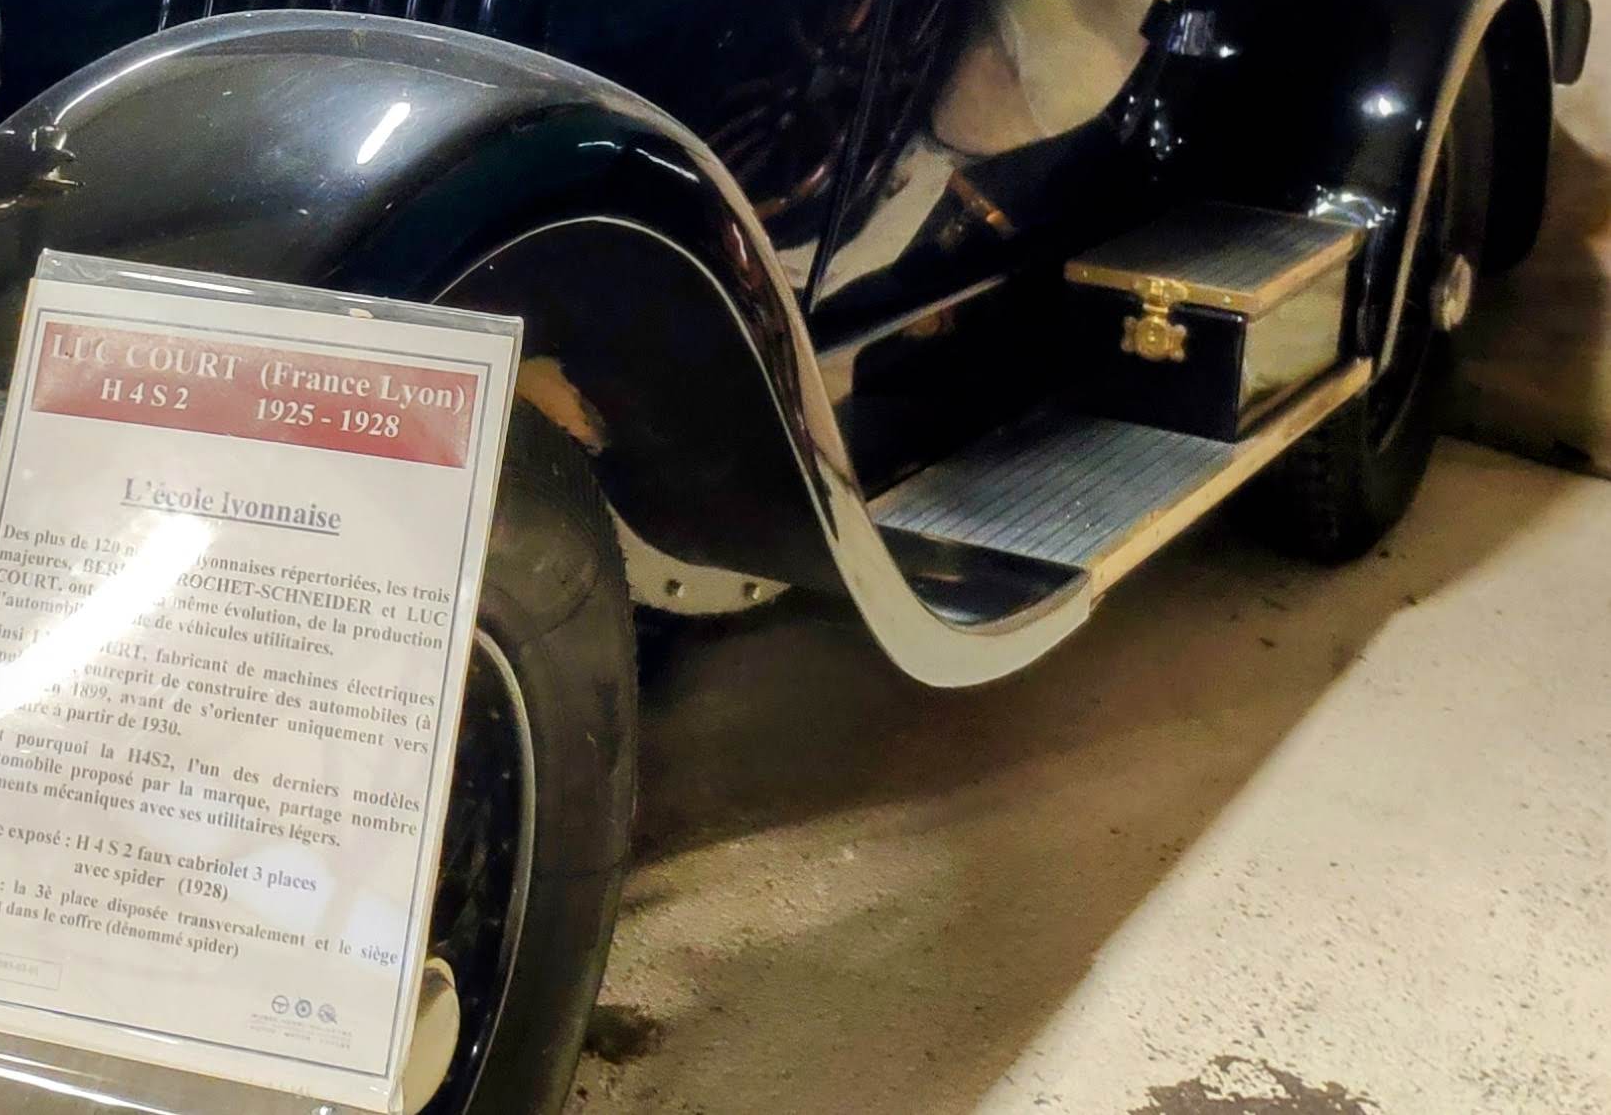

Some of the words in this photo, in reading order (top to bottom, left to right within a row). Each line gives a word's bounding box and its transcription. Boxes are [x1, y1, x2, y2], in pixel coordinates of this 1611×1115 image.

[50, 334, 112, 369] LUC
[125, 345, 242, 379] COURT
[260, 361, 369, 396] (France
[379, 375, 464, 414] Lyon)
[100, 378, 122, 401] H
[129, 382, 143, 403] 4
[150, 384, 167, 406] S
[173, 387, 188, 409] 2
[257, 398, 314, 425] 1925
[340, 409, 399, 437] 1928
[124, 477, 213, 511] L'école
[221, 491, 340, 529] lyonnaise
[0, 549, 71, 570] majeures,
[176, 572, 370, 614] ROCHET-SCHNEIDER
[381, 606, 395, 618] et
[407, 606, 447, 626] LUC
[3, 524, 29, 540] Des
[33, 529, 64, 546] plus
[70, 534, 85, 549] de
[94, 537, 120, 553] 120
[281, 565, 381, 593] répertoriées,
[386, 579, 406, 596] les
[412, 586, 449, 602] trois
[68, 582, 94, 595] ont
[173, 595, 218, 614] même
[224, 602, 300, 628] évolution,
[307, 615, 326, 630] de
[332, 617, 346, 634] la
[352, 625, 442, 649] production
[154, 614, 172, 630] de
[178, 620, 247, 641] véhicules
[253, 631, 333, 656] utilitaires.
[84, 665, 153, 685] entreprit
[161, 672, 179, 688] de
[186, 680, 267, 702] construire
[275, 691, 300, 707] des
[308, 700, 407, 726] automobiles
[415, 714, 430, 730] (à
[156, 648, 227, 672] fabricant
[236, 660, 254, 676] de
[263, 668, 337, 690] machines
[346, 678, 434, 706] électriques
[66, 708, 114, 724] partir
[117, 712, 135, 728] de
[142, 716, 181, 736] 1930.
[73, 682, 111, 703] 1899,
[119, 693, 163, 709] avant
[173, 697, 191, 714] de
[200, 702, 278, 727] s'orienter
[287, 719, 383, 746] uniquement
[393, 737, 427, 753] vers
[15, 733, 88, 754] pourquoi
[100, 742, 113, 759] la
[127, 747, 174, 771] H4S2,
[187, 757, 219, 776] l'un
[232, 766, 258, 783] des
[272, 772, 339, 797] derniers
[353, 789, 419, 811] modèles
[70, 766, 133, 786] proposé
[141, 777, 170, 792] par
[179, 779, 192, 796] la
[203, 788, 269, 811] marque,
[279, 801, 342, 824] partage
[351, 813, 416, 835] nombre
[43, 783, 134, 810] mécaniques
[139, 801, 174, 817] avec
[179, 809, 201, 821] ses
[207, 811, 283, 836] utilitaires
[288, 823, 340, 846] légers.
[8, 827, 60, 845] exposé
[76, 834, 89, 850] H
[93, 838, 103, 853] 4
[108, 840, 118, 855] S
[122, 842, 132, 858] 2
[137, 845, 171, 865] faux
[177, 855, 247, 878] cabriolet
[252, 866, 262, 881] 3
[266, 870, 316, 891] places
[73, 862, 109, 878] avec
[113, 868, 165, 887] spider
[177, 878, 227, 901] (1928)
[5, 901, 38, 918] dans
[43, 907, 55, 922] le
[59, 913, 101, 930] coffre
[105, 920, 182, 945] (dénommé
[187, 936, 238, 957] spider)
[13, 879, 26, 895] la
[60, 889, 98, 908] place
[106, 897, 168, 920] disposée
[177, 911, 304, 946] transversalement
[314, 938, 329, 951] et
[338, 939, 351, 954] le
[361, 945, 397, 965] siège
